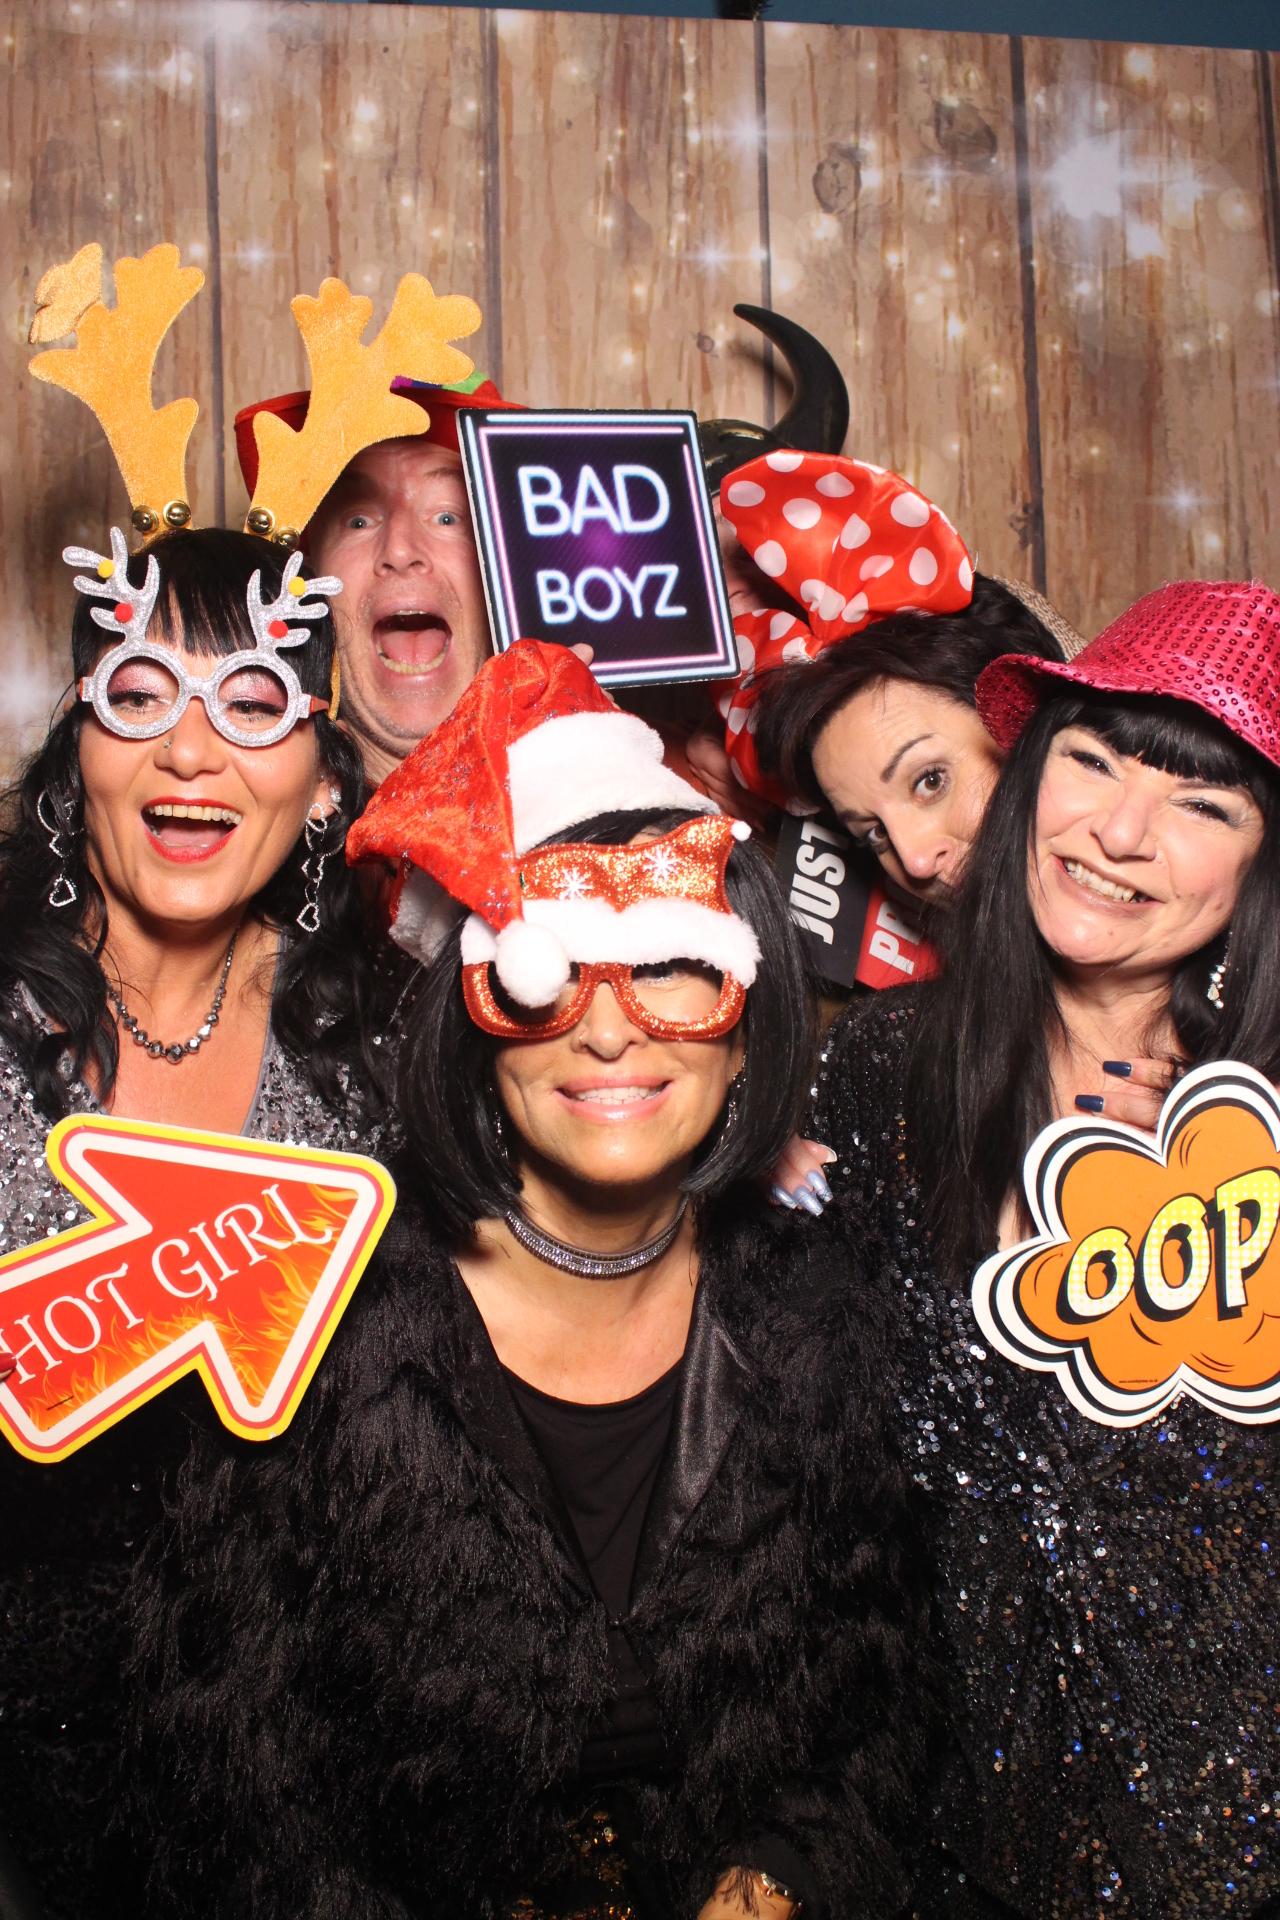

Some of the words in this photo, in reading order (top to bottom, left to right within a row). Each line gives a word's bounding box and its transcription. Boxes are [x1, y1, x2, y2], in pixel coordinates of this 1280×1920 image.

[517, 464, 670, 536] BAD
[536, 564, 688, 625] BOYZ
[789, 821, 849, 945] JUST
[0, 1262, 144, 1385] HOT
[151, 1184, 333, 1302] GIRL
